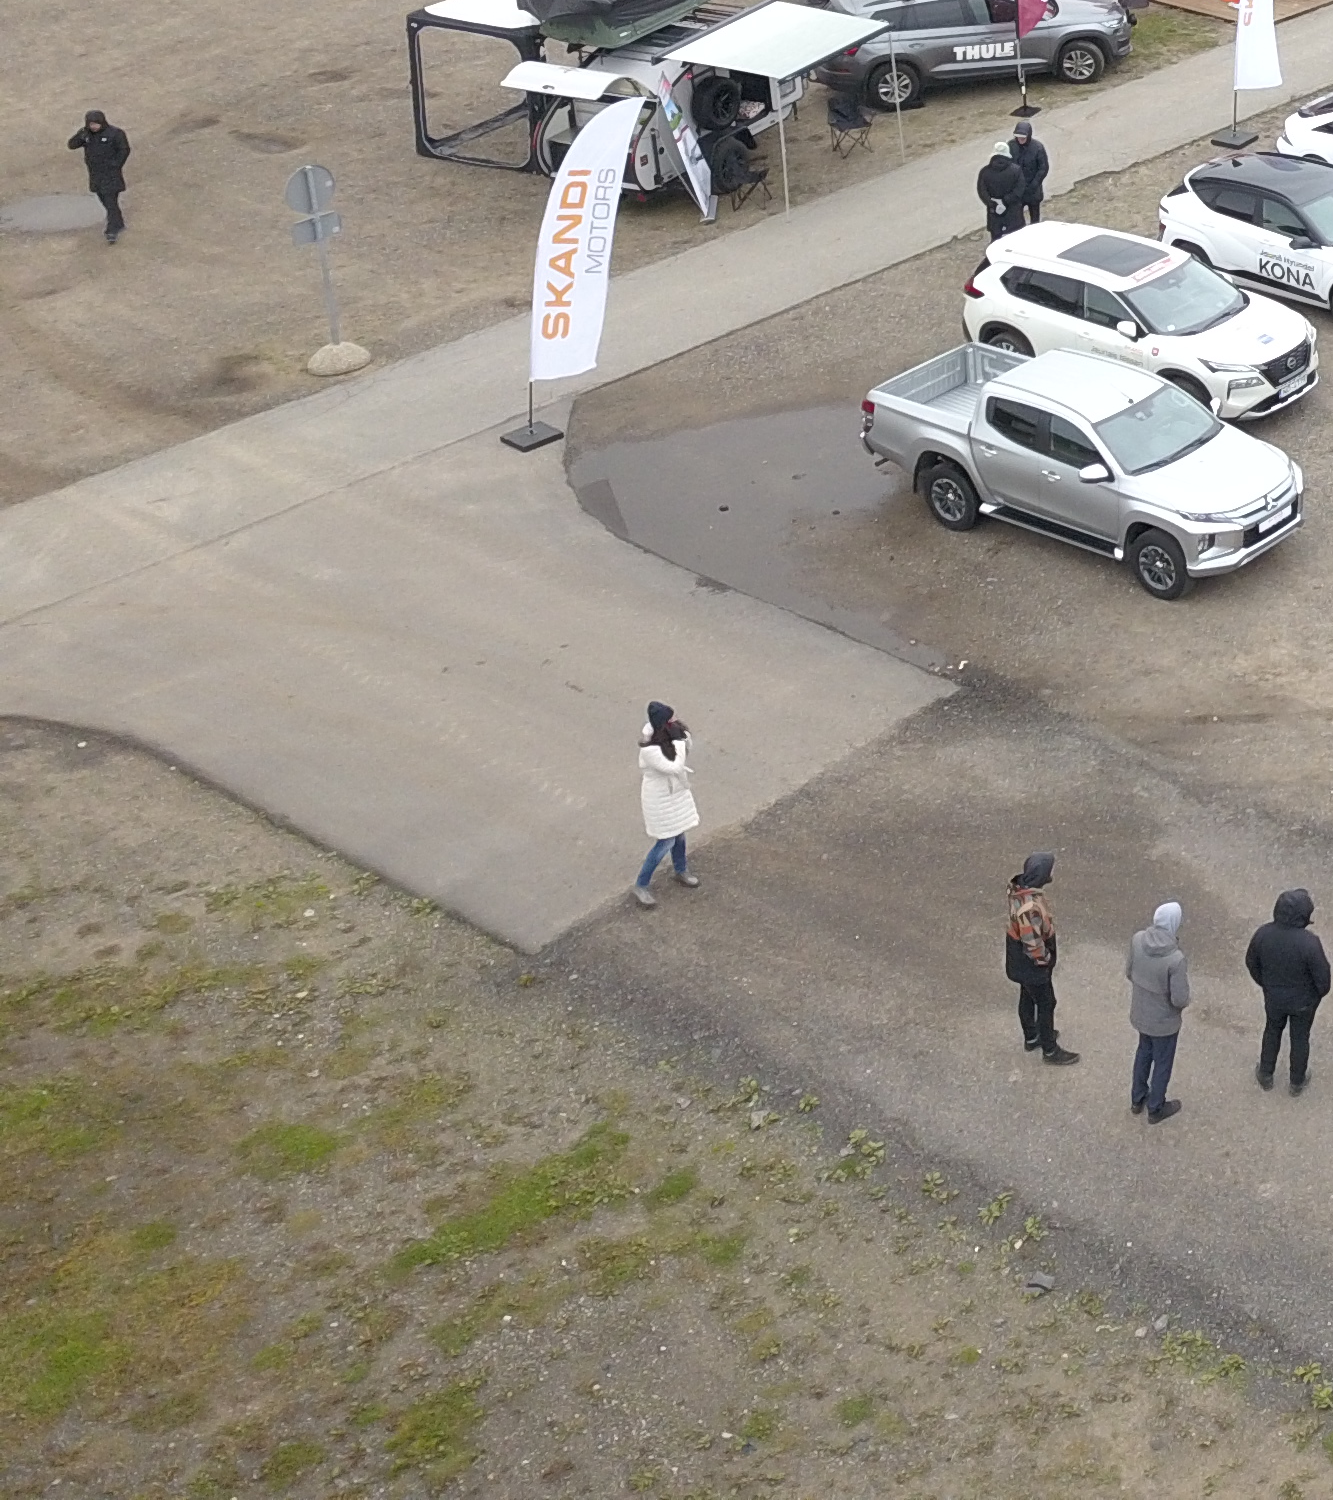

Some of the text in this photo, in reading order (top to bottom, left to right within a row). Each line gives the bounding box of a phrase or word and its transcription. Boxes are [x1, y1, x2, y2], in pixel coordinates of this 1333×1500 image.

[953, 41, 1015, 61] THULE
[541, 169, 592, 341] SKANDI
[584, 168, 617, 274] MOTORS
[1258, 257, 1317, 291] KONA
